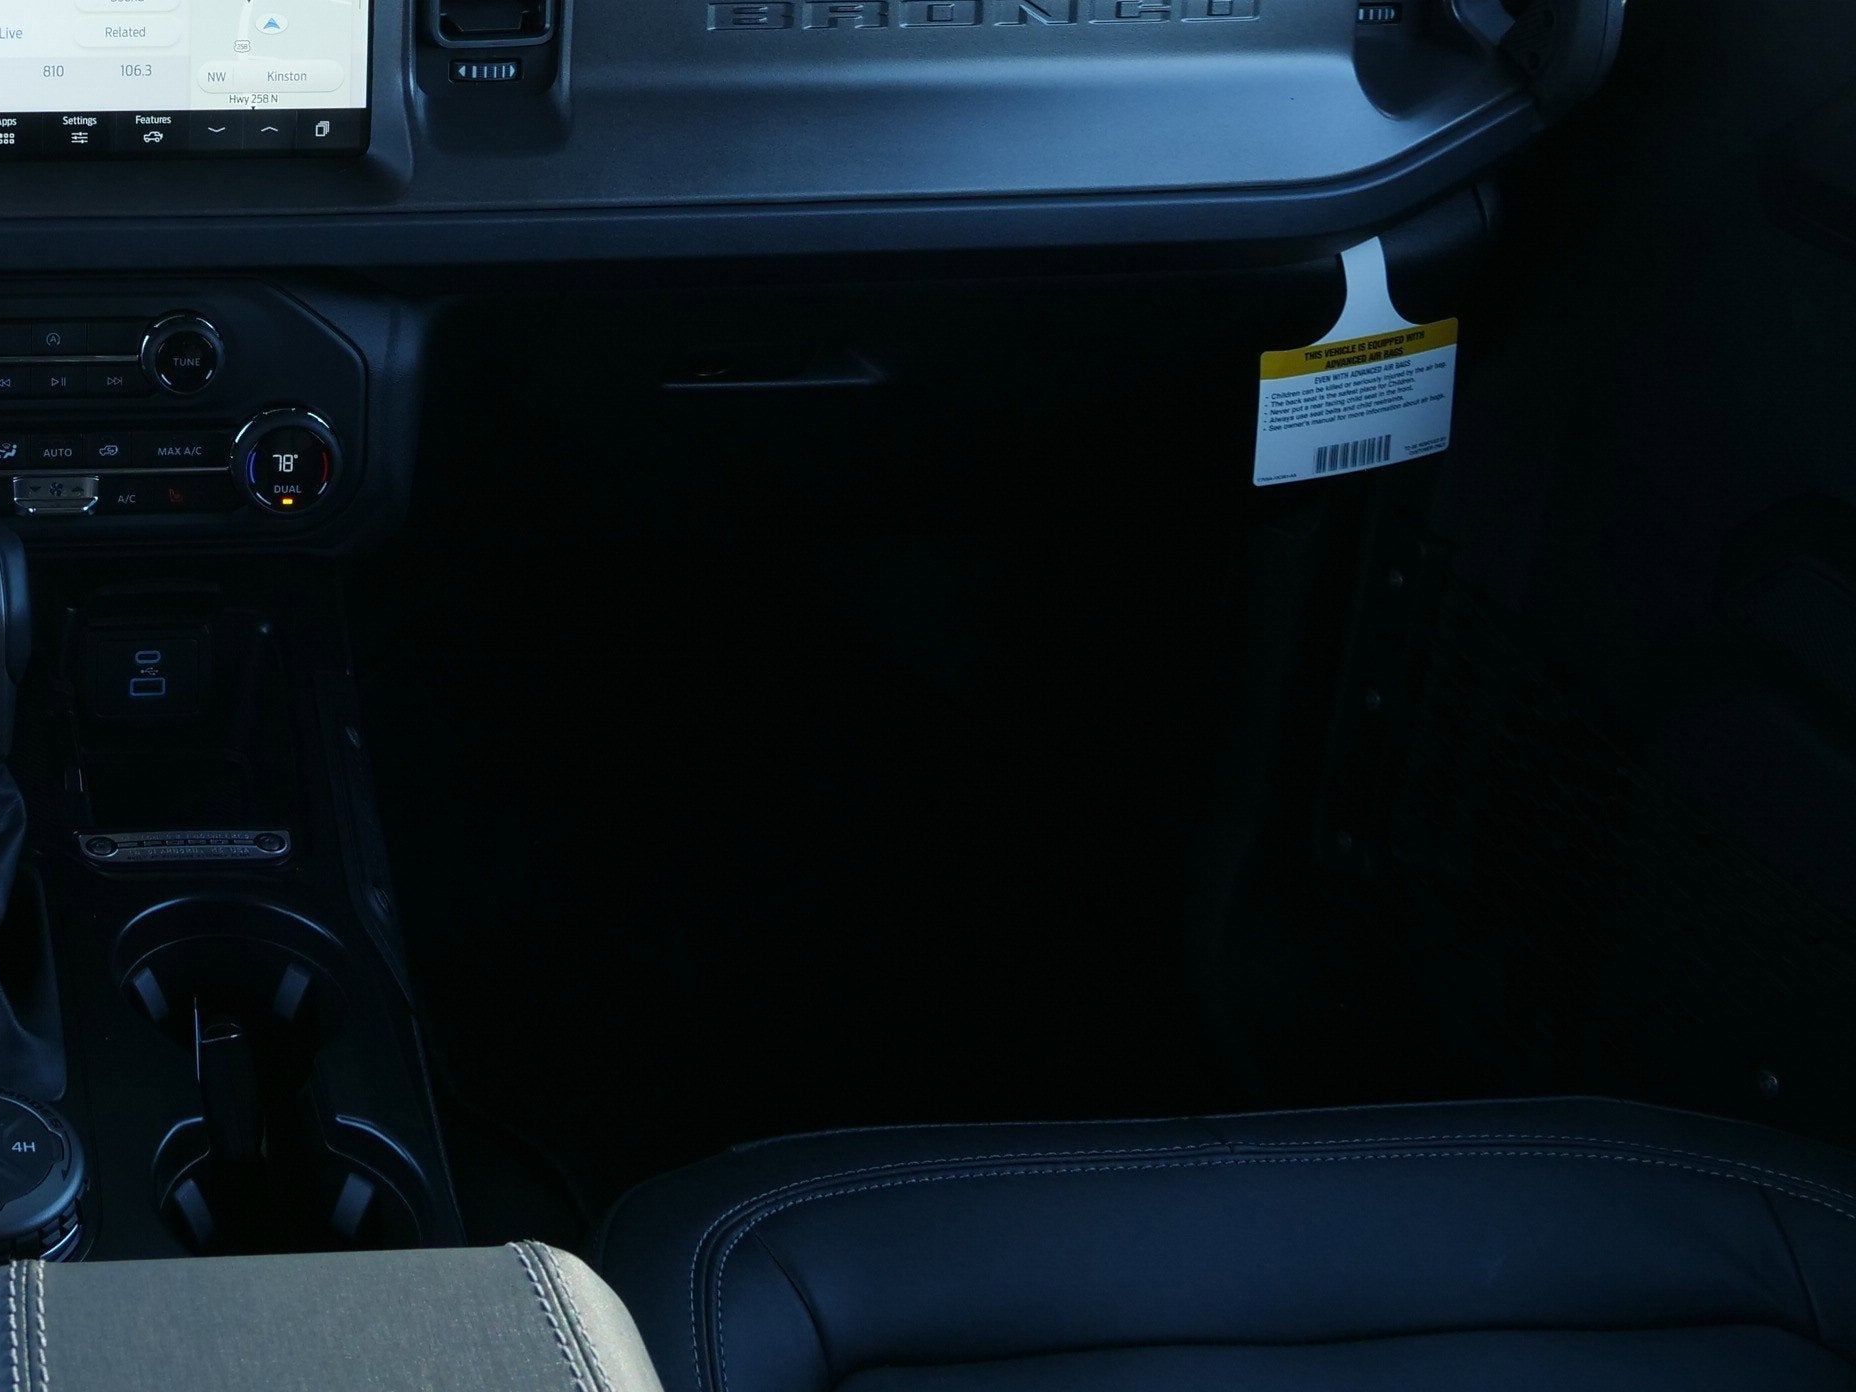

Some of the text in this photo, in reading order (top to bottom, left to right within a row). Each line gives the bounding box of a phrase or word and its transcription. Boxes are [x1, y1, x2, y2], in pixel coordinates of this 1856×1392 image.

[105, 26, 146, 38] Related
[42, 65, 65, 78] 810
[120, 64, 153, 77] 106.3
[207, 71, 227, 82] NW
[267, 71, 307, 82] Kinston
[229, 94, 279, 105] Hwy 258 N
[62, 115, 97, 127] Settings
[135, 115, 172, 125] Features
[1304, 350, 1323, 361] THIS
[1324, 344, 1357, 358] VEHICLE
[1367, 335, 1404, 350] EQUIPPED
[1406, 330, 1425, 343] WITH
[172, 357, 201, 367] TUNE
[1325, 354, 1367, 369] ADVANCED
[1369, 351, 1382, 362] AIR
[1271, 389, 1301, 400] Children
[43, 448, 73, 458] AUTO
[157, 446, 203, 457] MAX A/C
[273, 483, 302, 495] DUAL
[117, 493, 137, 505] A/C
[11, 1141, 37, 1153] 4H
